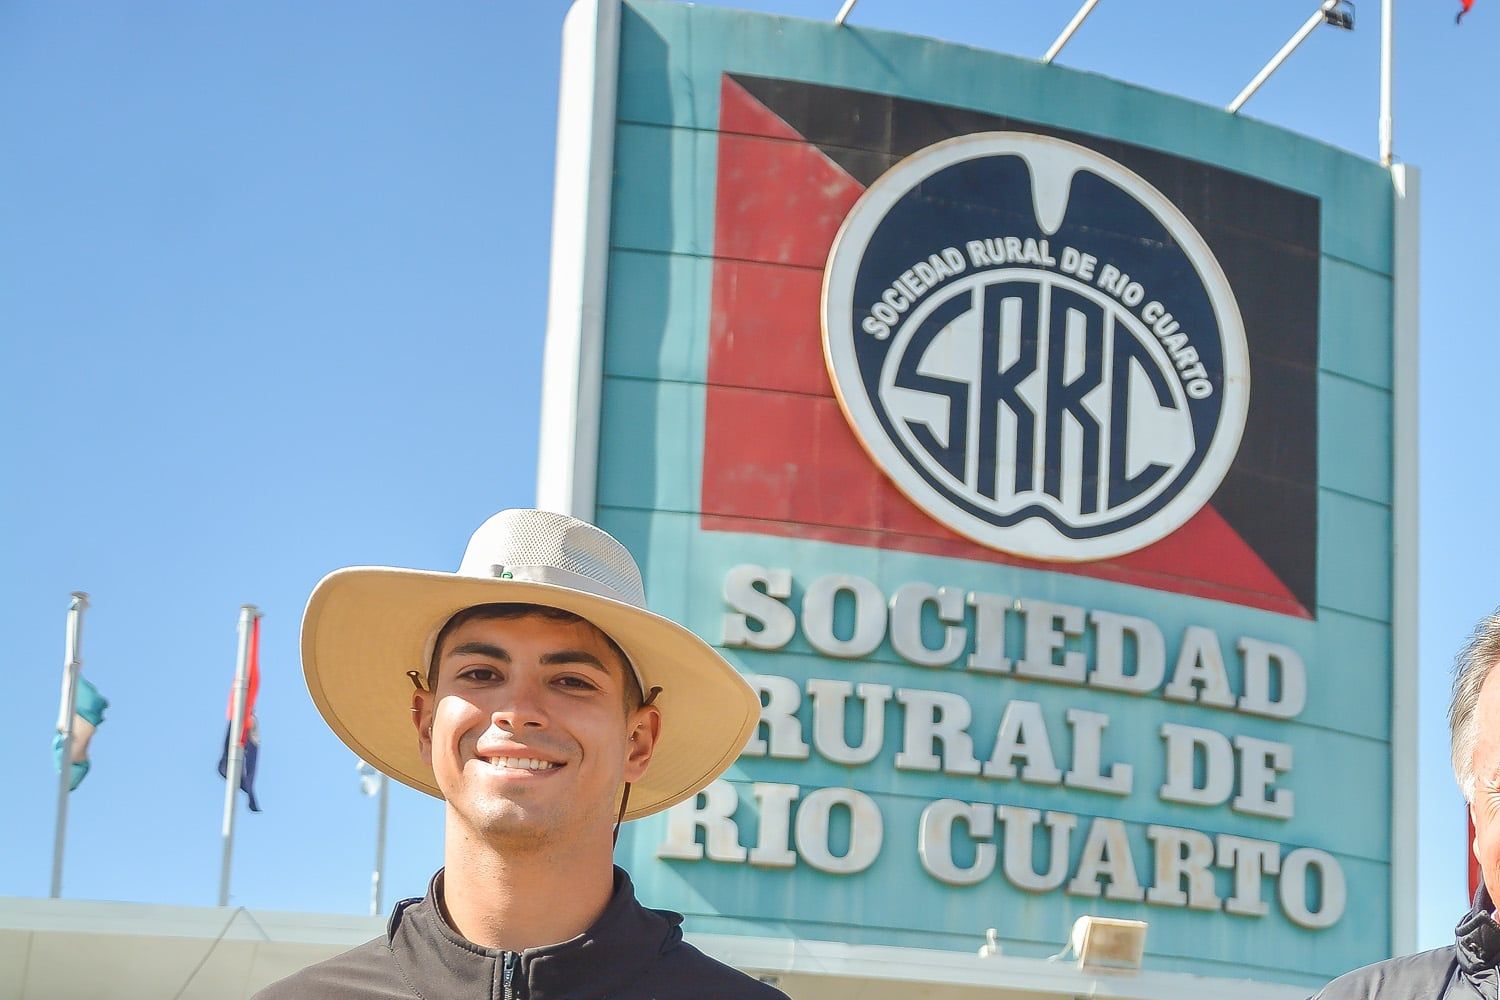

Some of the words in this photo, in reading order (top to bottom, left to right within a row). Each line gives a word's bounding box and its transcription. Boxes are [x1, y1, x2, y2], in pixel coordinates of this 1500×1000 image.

[862, 246, 966, 340] SOCIEDAD
[966, 236, 1056, 268] RURAL
[1060, 246, 1097, 281] DE
[1097, 263, 1144, 306] RIO
[1141, 300, 1213, 399] CUARTO
[893, 281, 1180, 516] SRRC
[722, 564, 1307, 720] SOCIEDAD
[740, 674, 1133, 796] RURAL
[1160, 722, 1294, 819] DE
[657, 779, 884, 875] RIO
[918, 798, 1347, 929] CUARTO
